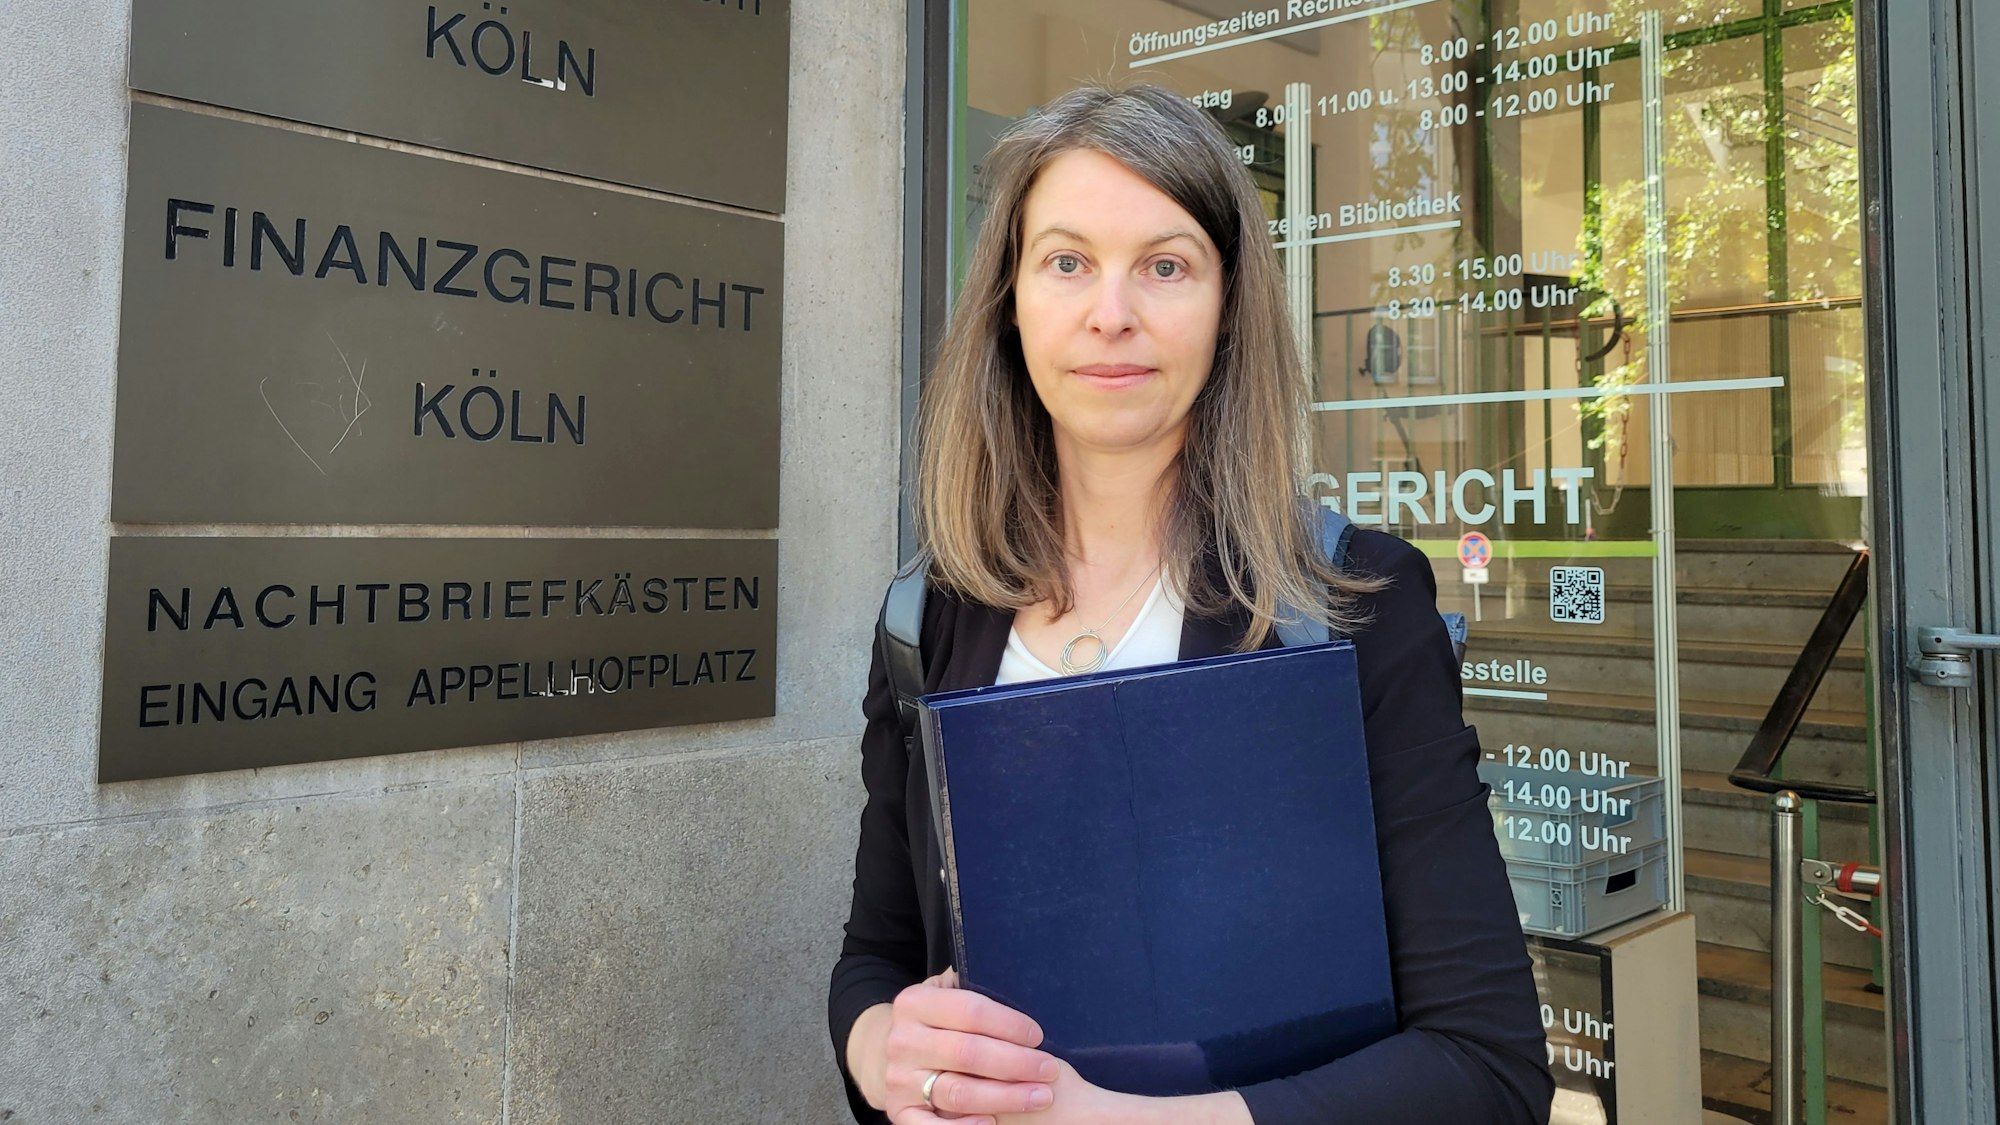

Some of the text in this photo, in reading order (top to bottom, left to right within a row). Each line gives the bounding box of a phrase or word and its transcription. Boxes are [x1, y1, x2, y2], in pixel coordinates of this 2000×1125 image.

[426, 2, 596, 98] KÖLN
[1128, 7, 1280, 55] Öffnungszeiten
[1419, 36, 1468, 66] 8.00
[1491, 19, 1557, 52] 12.00
[1566, 11, 1614, 37] Uhr
[1317, 88, 1372, 117] 11.00
[1379, 88, 1399, 107] u.
[1407, 70, 1468, 100] 13.00
[1475, 76, 1485, 84] -
[1491, 53, 1557, 85] 14.00
[1566, 46, 1615, 72] Uhr
[1419, 80, 1615, 131] 8.00 - 12.00 Uhr
[1339, 191, 1461, 227] Bibliothek
[165, 198, 765, 332] FINANZGERICHT
[1388, 249, 1579, 288] 8.30 - 15.00 Uhr
[1388, 284, 1579, 320] 8.30 - 14.00 Uhr
[413, 368, 586, 445] KÖLN
[147, 572, 760, 632] NACHTBRIEFKÄSTEN
[138, 649, 756, 728] EINGANG APPELLHOFPLATZ
[1502, 743, 1571, 773] 12.00
[1579, 751, 1630, 779] Uhr
[1503, 779, 1631, 817] 14.00 Uhr
[1503, 815, 1632, 855] 12.00 Uhr
[1563, 1007, 1614, 1041] Uhr
[1564, 1045, 1615, 1080] Uhr
